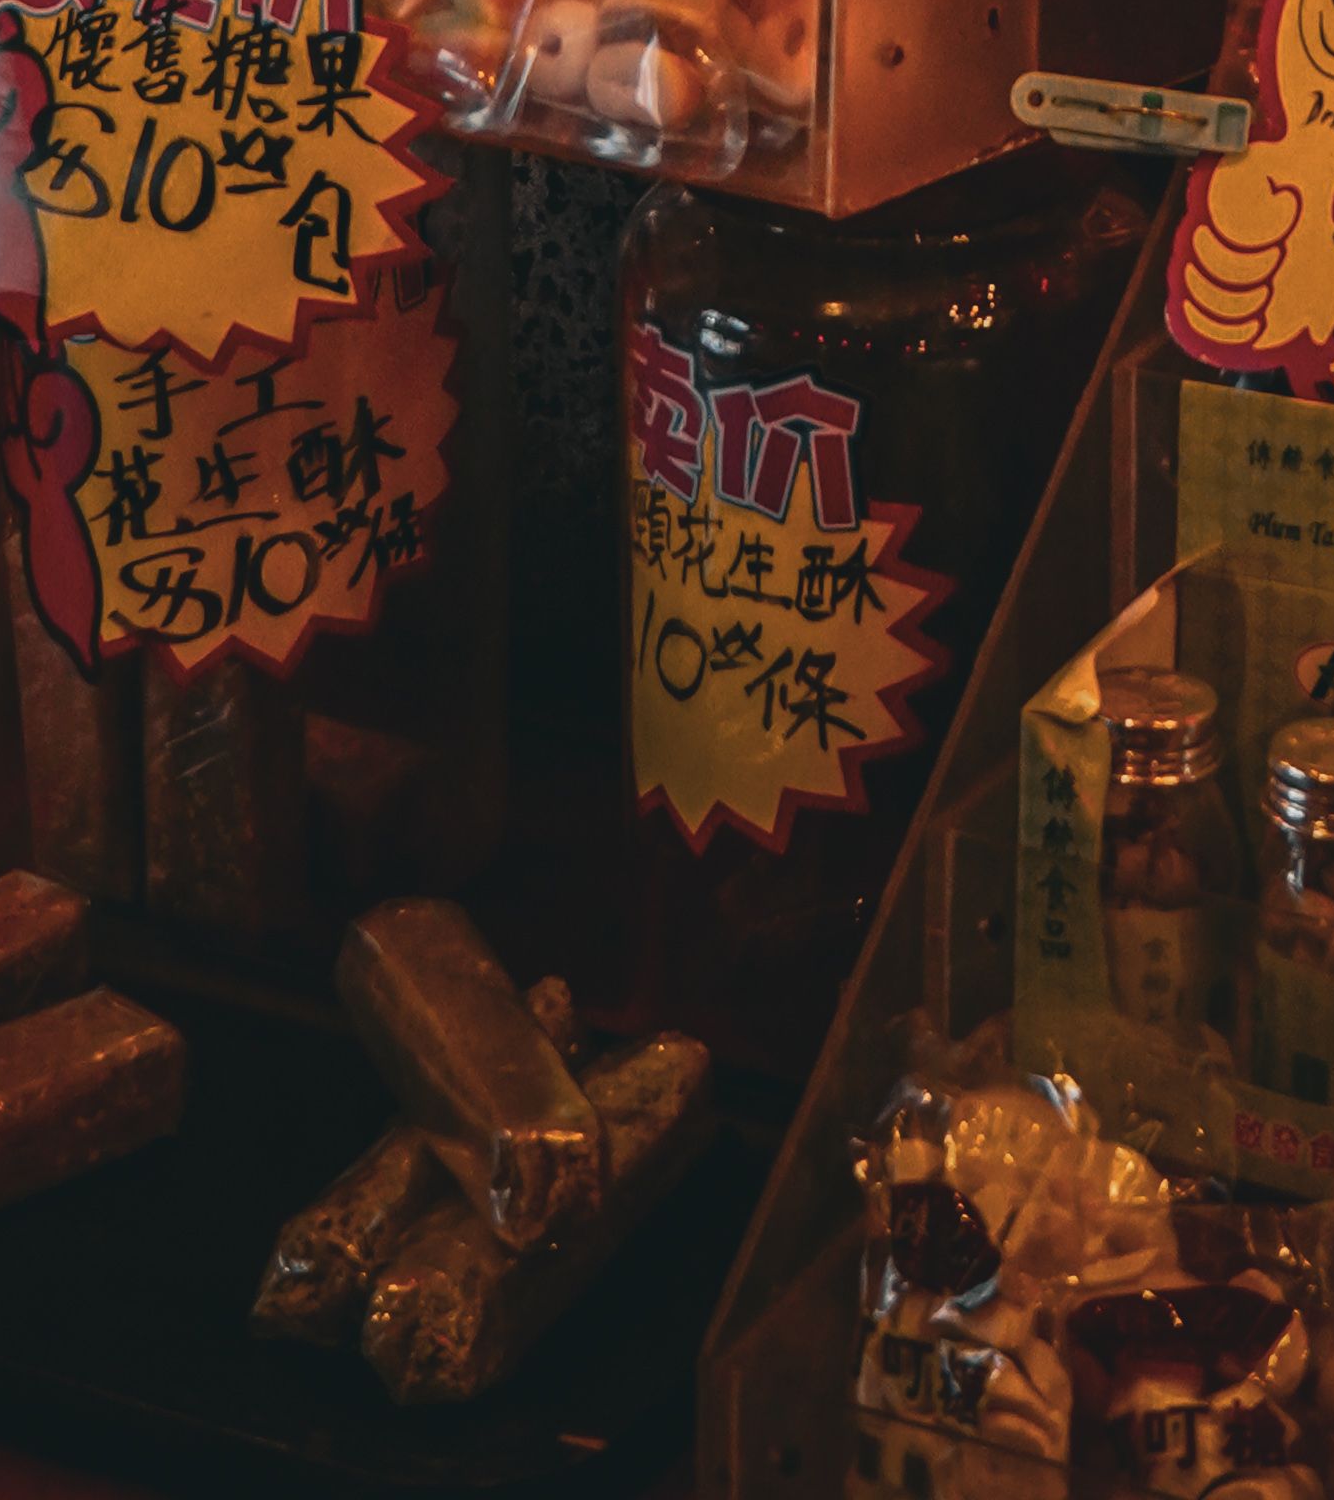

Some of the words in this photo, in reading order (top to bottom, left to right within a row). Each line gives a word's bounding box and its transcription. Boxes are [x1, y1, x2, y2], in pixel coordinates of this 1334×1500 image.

[278, 169, 352, 295] 包
[113, 348, 325, 440] 手工
[89, 396, 406, 548] 花生酥
[1247, 510, 1304, 547] Plum
